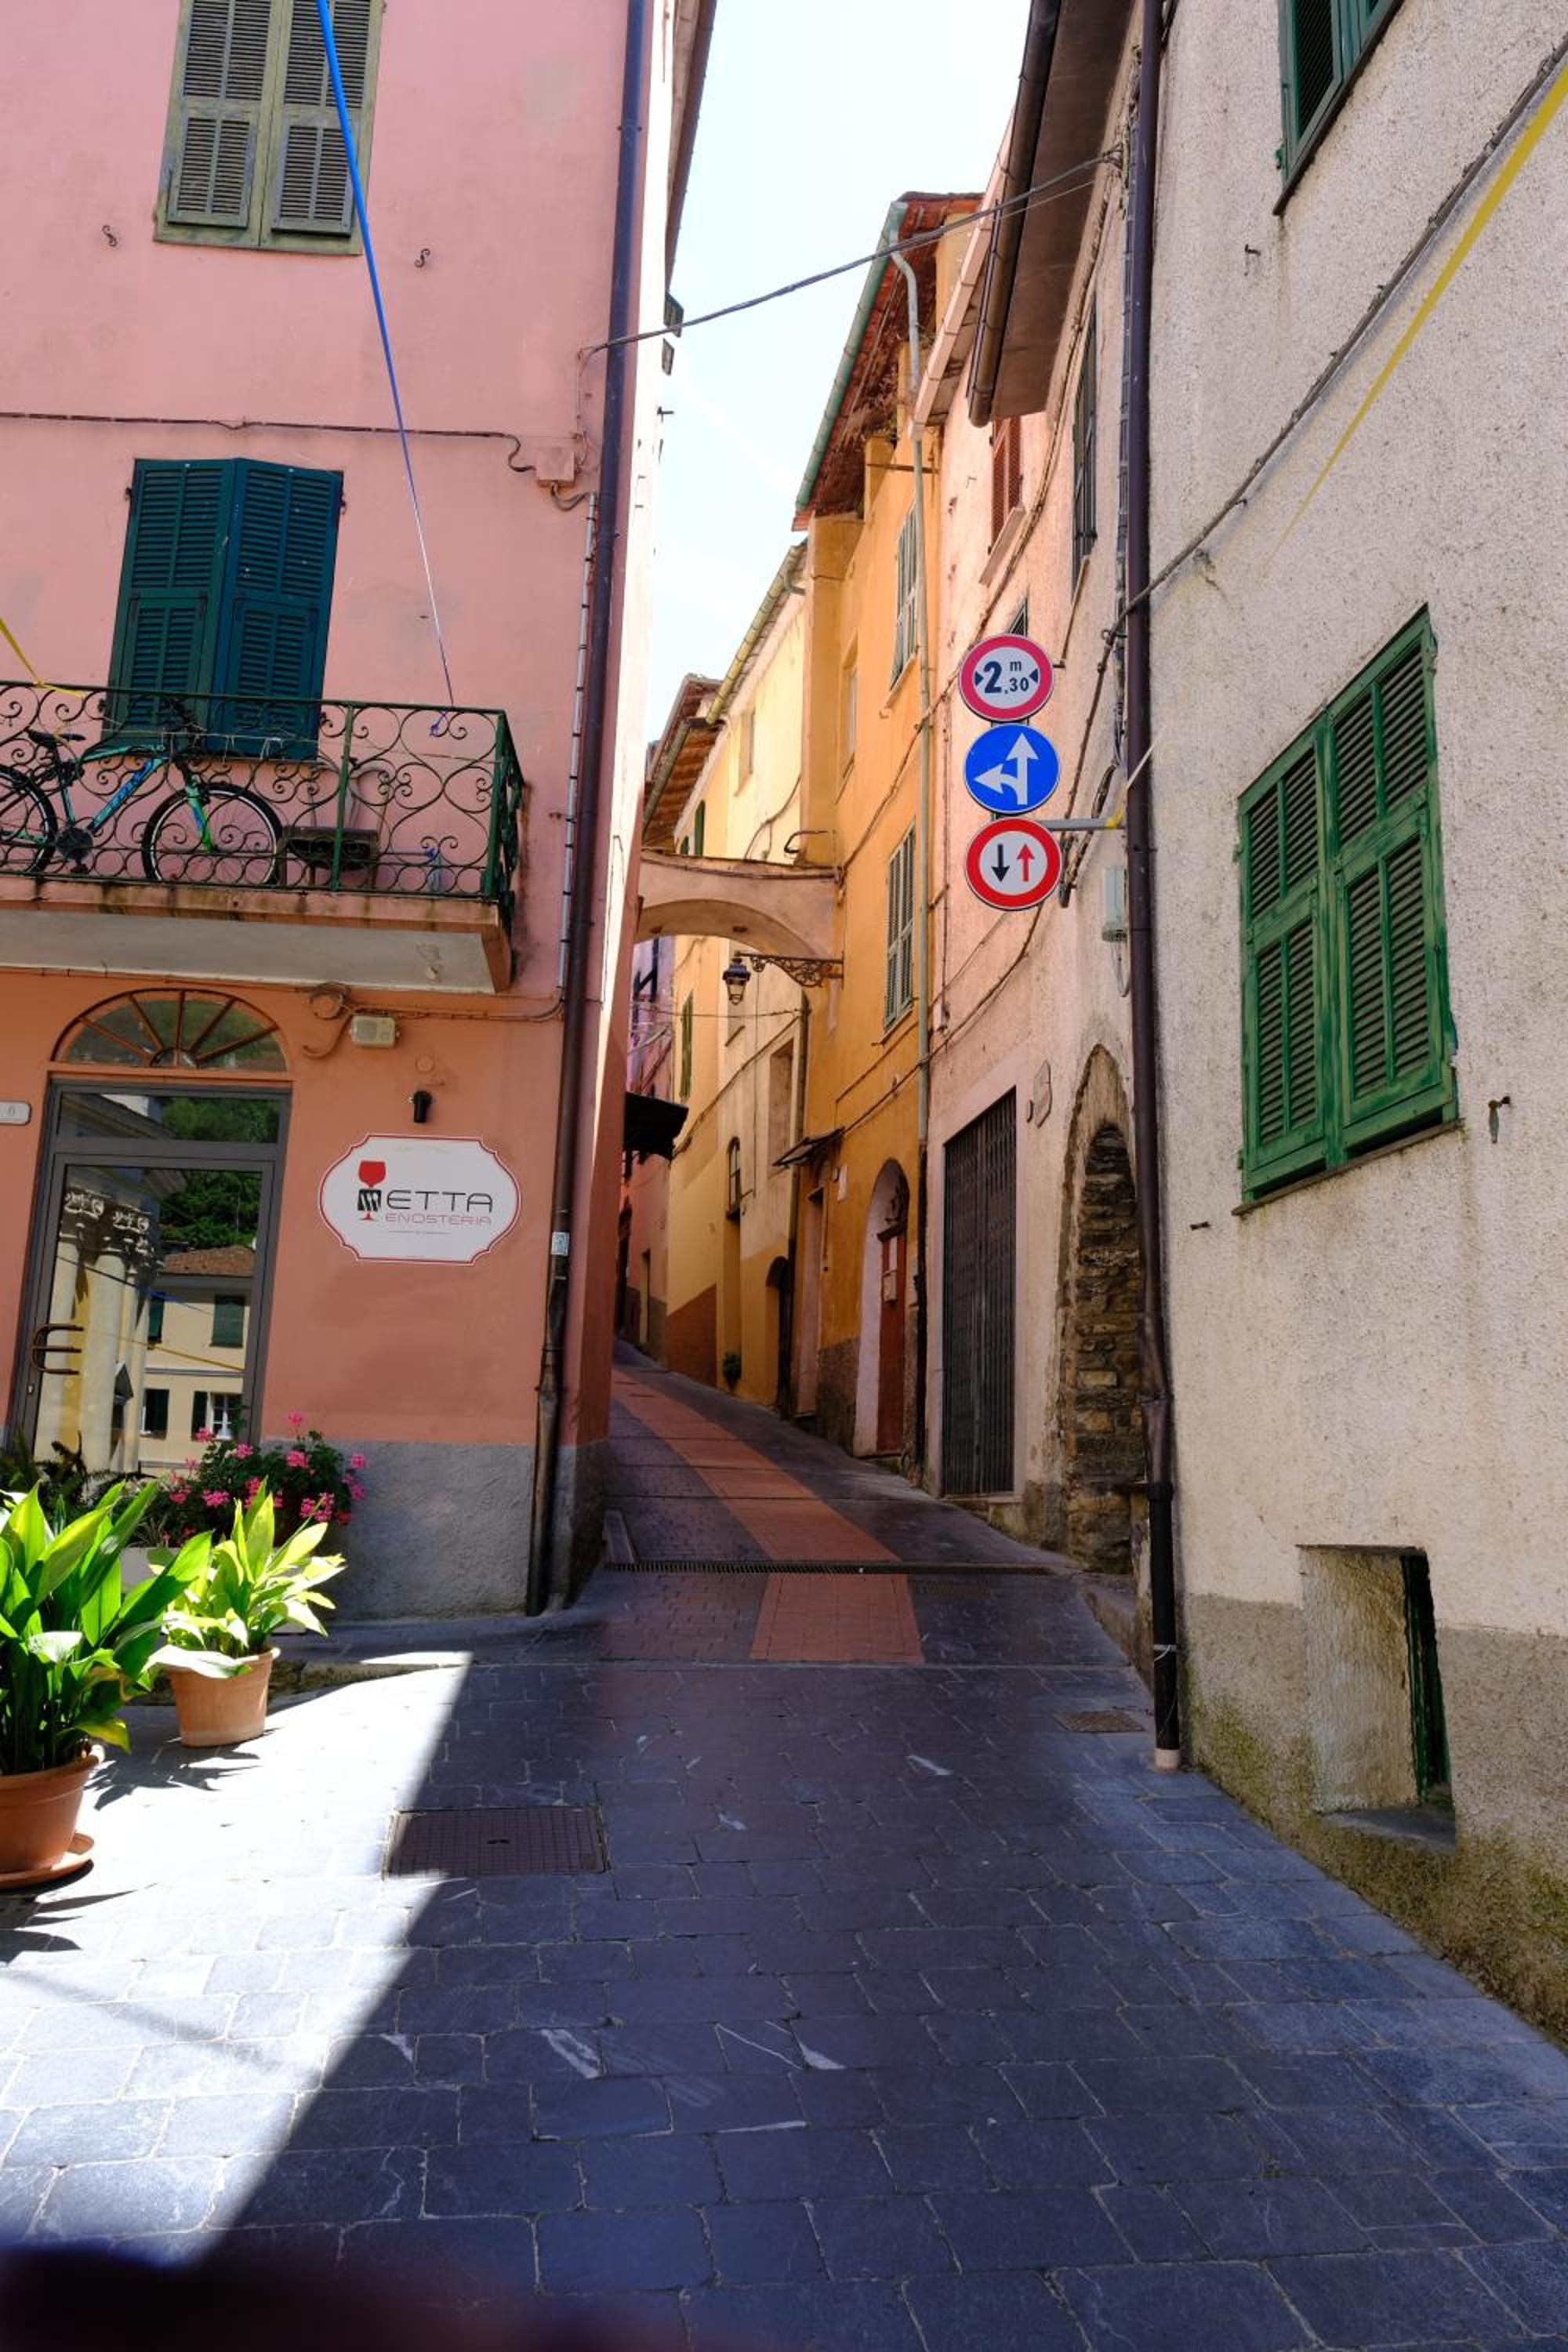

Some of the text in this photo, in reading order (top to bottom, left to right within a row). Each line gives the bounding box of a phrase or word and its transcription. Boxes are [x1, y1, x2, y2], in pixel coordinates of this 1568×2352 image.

[1009, 661, 1022, 672] m
[358, 1189, 493, 1213] METTA
[385, 1213, 492, 1225] ENOSTERIA
